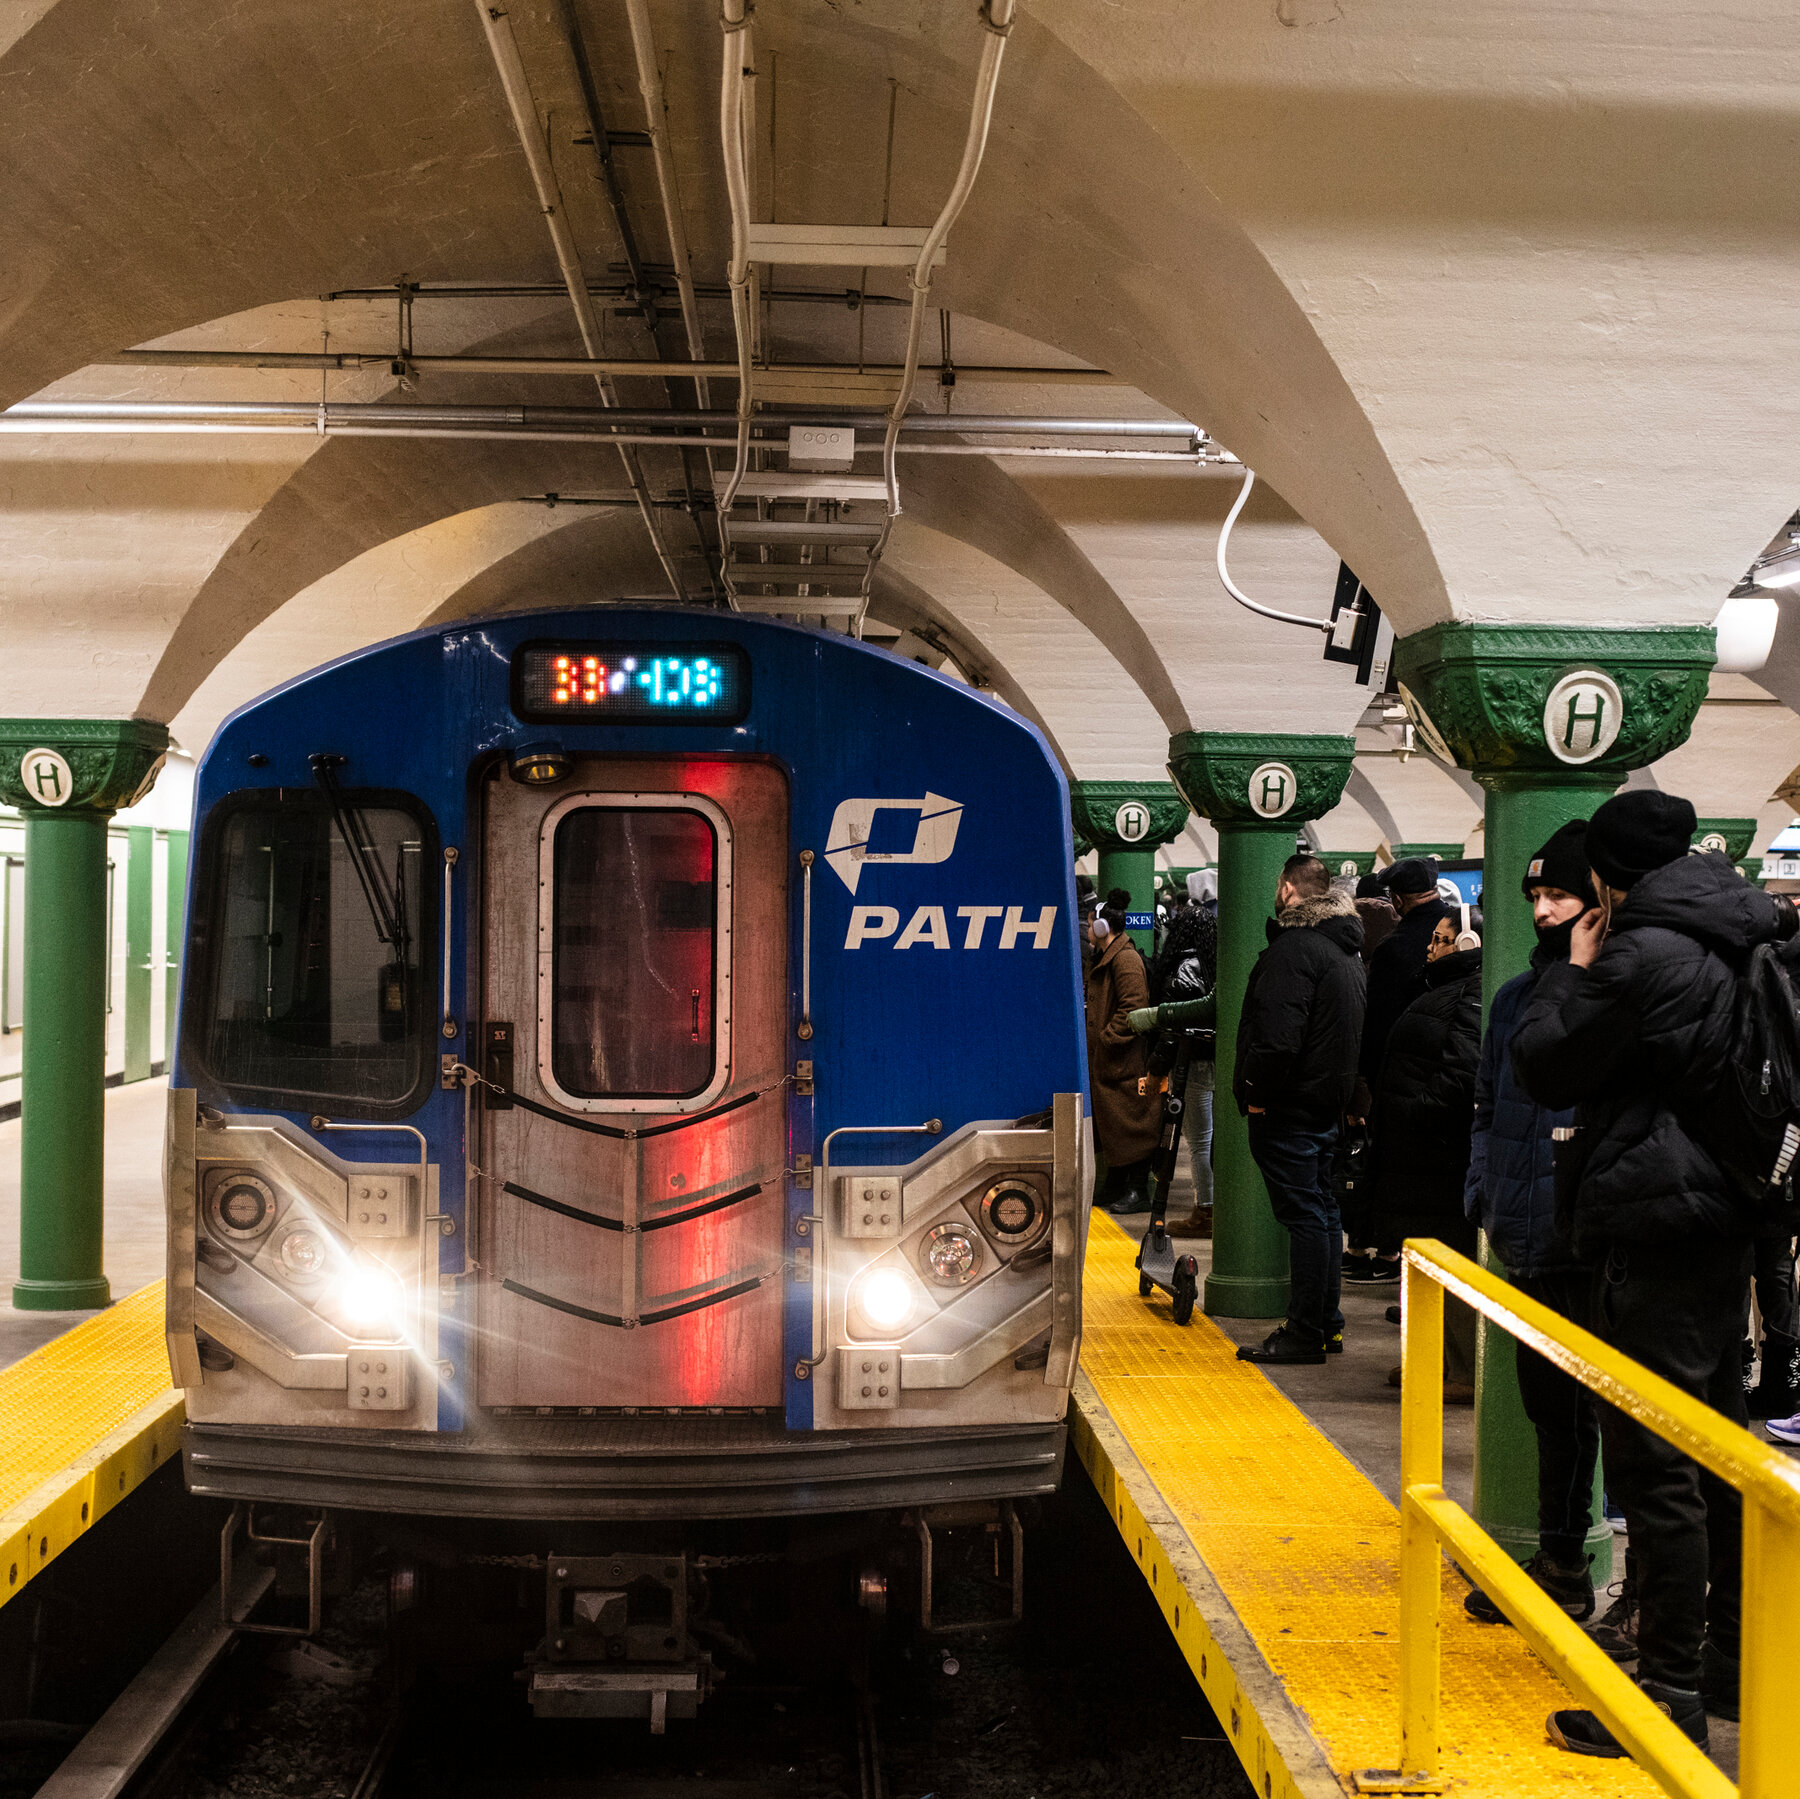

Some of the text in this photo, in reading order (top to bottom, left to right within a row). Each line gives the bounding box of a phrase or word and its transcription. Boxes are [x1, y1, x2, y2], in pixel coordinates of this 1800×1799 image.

[1562, 692, 1606, 749] H
[33, 762, 62, 798] H
[1260, 775, 1287, 811] H
[1124, 811, 1142, 835] H
[844, 905, 1058, 950] PATH
